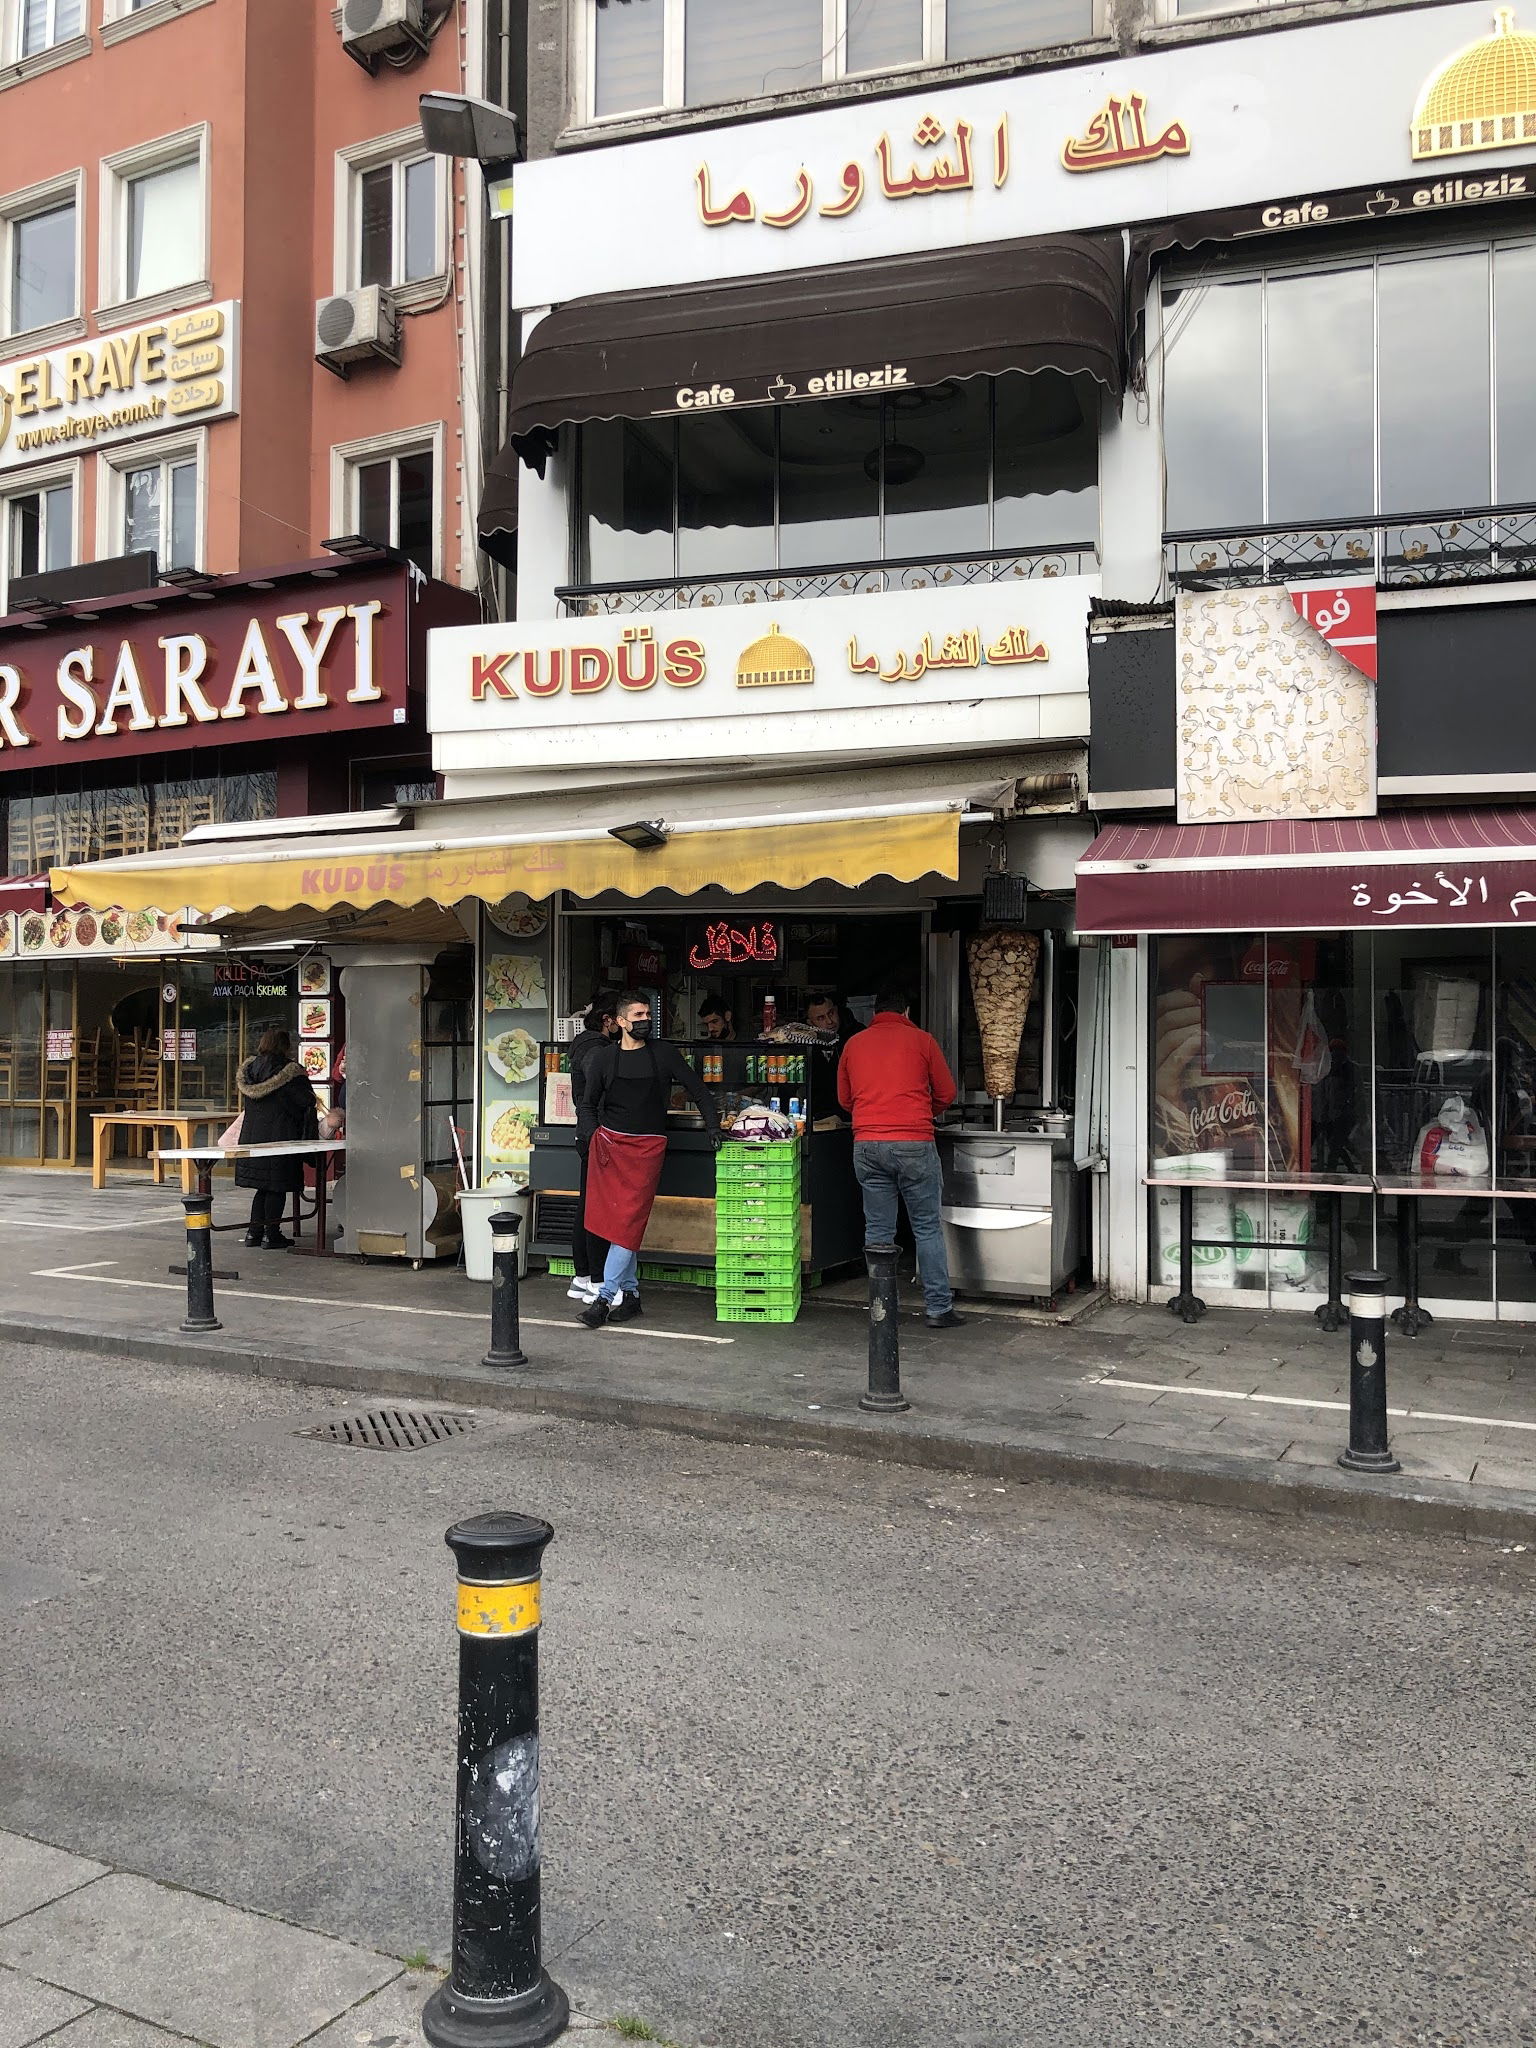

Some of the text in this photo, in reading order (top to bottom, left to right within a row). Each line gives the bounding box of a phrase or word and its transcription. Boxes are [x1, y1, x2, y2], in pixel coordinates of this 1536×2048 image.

[695, 88, 1191, 229] ملك الشاورما
[1261, 173, 1527, 228] Cafe etileziz
[172, 317, 214, 344] سفر
[15, 326, 167, 418] EL RAYE
[171, 351, 215, 373] سياحة
[170, 383, 213, 406] رحلات
[676, 364, 908, 409] Cafe etileziz
[15, 394, 166, 451] www.elraye.com.tr
[57, 600, 381, 741] SARAYI
[471, 625, 707, 700] KUDÜS
[847, 625, 1050, 682] ملك الشاورما
[301, 854, 406, 895] KUDÜS
[523, 846, 566, 873] ملك
[1351, 871, 1488, 915] الأخوة
[690, 922, 777, 969] فلافل
[1243, 960, 1290, 975] CocaCola
[213, 982, 287, 997] AYAK PAÇA İŞKEMBE
